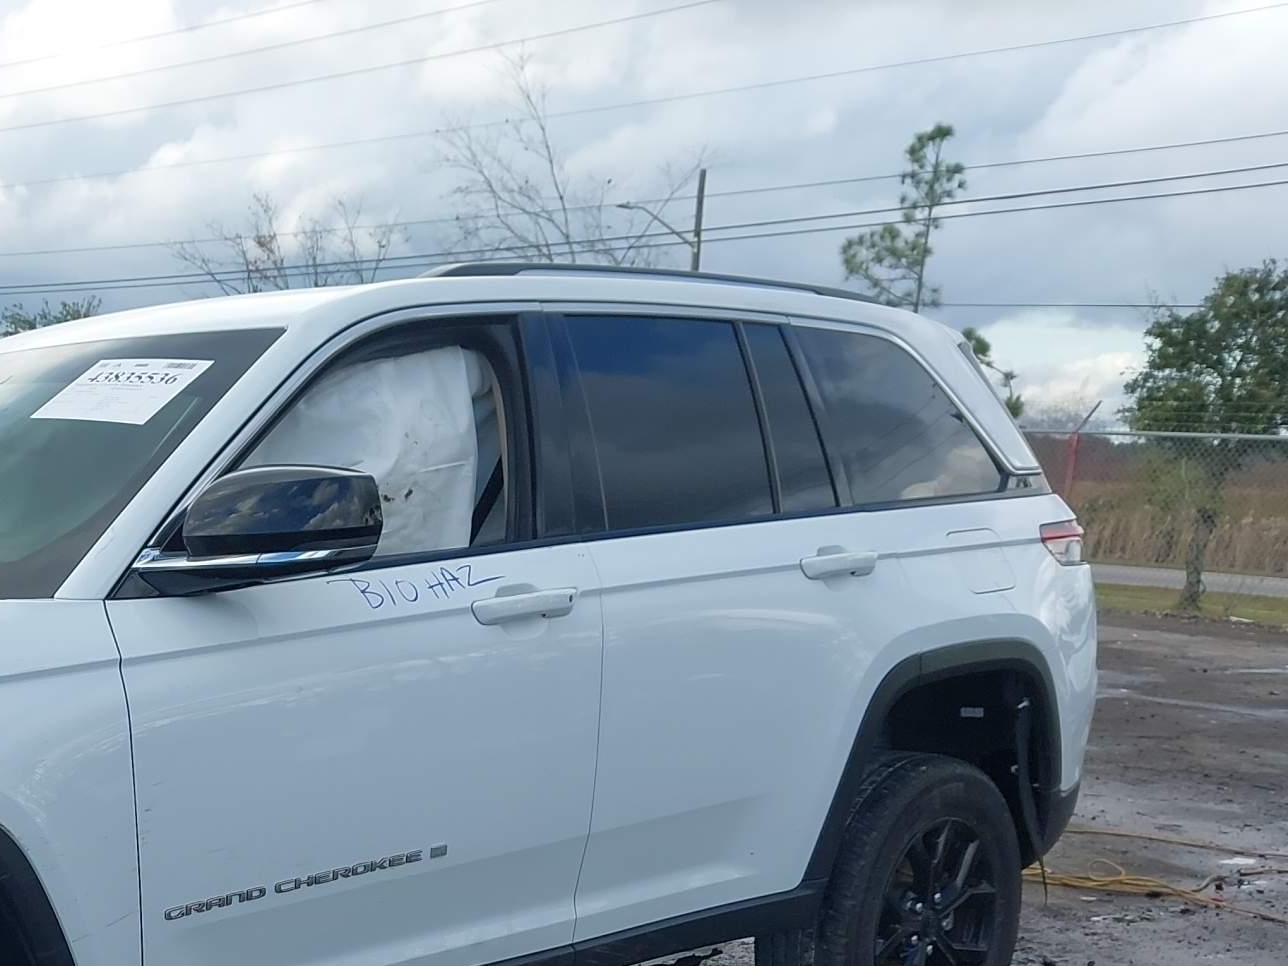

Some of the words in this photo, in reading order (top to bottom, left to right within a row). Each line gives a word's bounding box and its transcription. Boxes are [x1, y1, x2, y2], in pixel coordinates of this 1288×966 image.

[87, 371, 180, 385] 43835536
[164, 886, 267, 921] GRAND
[274, 850, 423, 894] CHEROKEE
